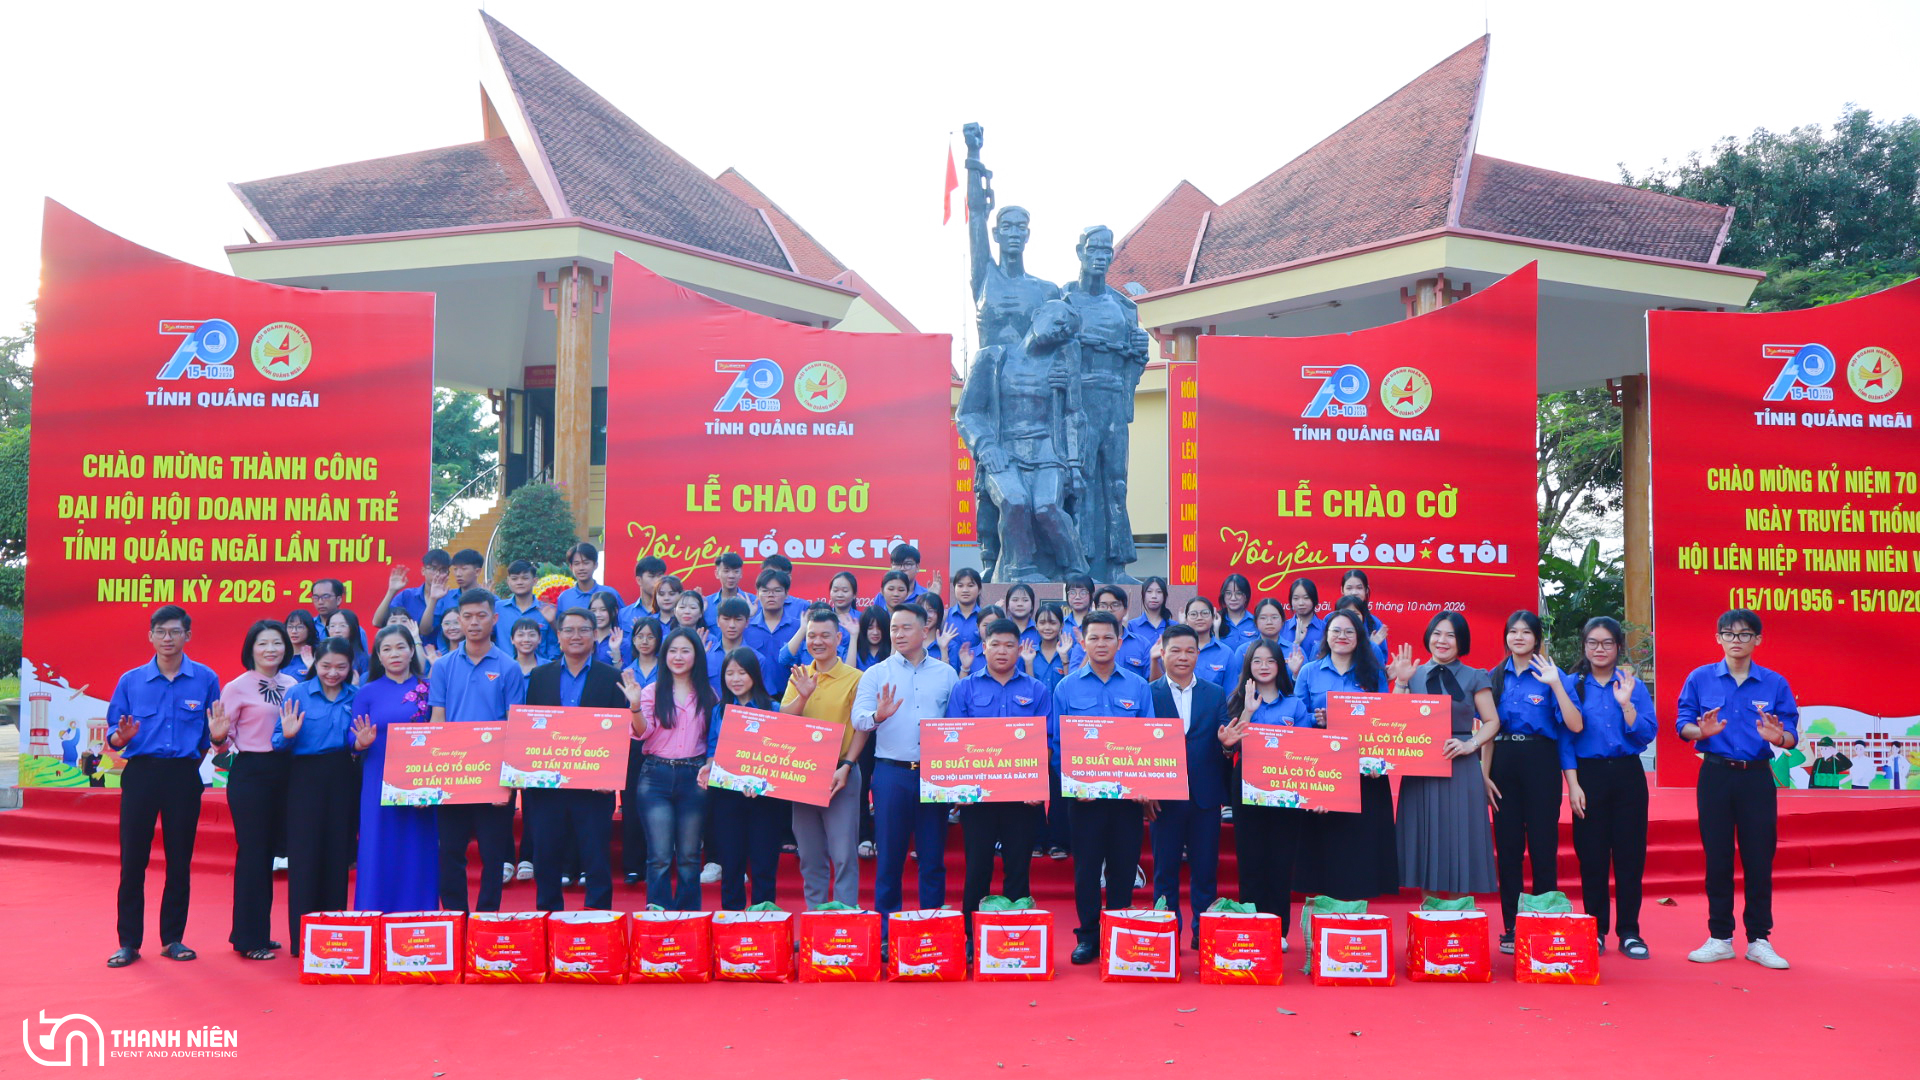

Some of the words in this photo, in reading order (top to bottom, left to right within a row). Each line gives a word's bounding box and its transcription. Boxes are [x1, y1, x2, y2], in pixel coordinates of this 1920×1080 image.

[188, 366, 218, 377] 15-10
[146, 387, 191, 405] TỈNH
[198, 388, 265, 407] QUẢNG
[272, 391, 318, 407] NGÃI
[1792, 388, 1819, 399] 15-10
[741, 400, 766, 410] 15-10
[1328, 406, 1353, 415] 15-10
[705, 419, 743, 434] TỈNH
[749, 419, 807, 436] QUẢNG
[813, 421, 853, 435] NGÃI
[1183, 411, 1196, 428] BAY
[1754, 408, 1796, 425] TỈNH
[1802, 409, 1863, 427] QUẢNG
[1869, 412, 1912, 428] NGÃI
[1293, 424, 1331, 440] TỈNH
[1337, 425, 1394, 441] QUẢNG
[1400, 427, 1439, 441] NGÃI
[1182, 438, 1196, 459] LÊN
[82, 454, 145, 478] CHÀO
[153, 452, 223, 479] MỪNG
[230, 452, 306, 479] THÀNH
[314, 452, 377, 480] CÔNG
[1707, 464, 1754, 491] CHÀO
[1760, 465, 1812, 492] MỪNG
[1818, 463, 1839, 492] KỶ
[1845, 466, 1890, 498] NIỆM
[1895, 471, 1917, 494] 70
[686, 474, 720, 511] LỄ
[732, 479, 816, 512] CHÀO
[827, 479, 869, 512] CỜ
[1278, 480, 1312, 517] LỄ
[1323, 484, 1405, 517] CHÀO
[1416, 484, 1458, 518] CỜ
[58, 495, 97, 524] ĐẠI
[105, 491, 143, 524] HỘI
[152, 492, 190, 525] HỘI
[198, 497, 277, 520] DOANH
[285, 494, 349, 521] NHÂN
[357, 491, 398, 522] TRẺ
[1746, 504, 1792, 531] NGÀY
[1798, 503, 1864, 532] TRUYỀN
[63, 530, 116, 560] TỈNH
[124, 531, 203, 564] QUẢNG
[211, 534, 267, 562] NGÃI
[275, 531, 319, 562] LẦN
[327, 535, 374, 563] THỨ
[377, 538, 392, 566] I,
[741, 528, 778, 558] TỔ
[1333, 534, 1369, 562] TỔ
[1460, 540, 1507, 563] TÔI
[1678, 542, 1708, 574] HỘI
[1713, 543, 1752, 570] LIÊN
[1758, 544, 1797, 576] HIỆP
[1803, 548, 1860, 572] THANH
[1866, 545, 1908, 572] NIÊN
[98, 579, 175, 607] NHIỆM
[182, 579, 211, 604] KỲ
[219, 580, 275, 603] 2026
[299, 580, 353, 606] 21
[1730, 587, 1832, 611] (15/10/1956
[1375, 602, 1403, 613] tháng
[1407, 602, 1417, 610] 10
[1419, 602, 1441, 611] năm
[1444, 602, 1465, 611] 2026
[1365, 733, 1374, 742] LÁ
[1377, 733, 1390, 743] CỜ
[1392, 732, 1403, 743] TỔ
[1406, 733, 1431, 744] QUỐC
[1071, 756, 1083, 764] 50
[1086, 753, 1110, 765] SUẤT
[1112, 755, 1134, 765] QUÀ
[1137, 758, 1151, 766] AN
[1154, 758, 1176, 766] SINH
[1368, 744, 1384, 755] TẤN
[1386, 748, 1395, 756] XI
[1398, 747, 1424, 757] MĂNG
[736, 750, 750, 759] 200
[752, 751, 762, 761] LÁ
[764, 754, 778, 763] CỜ
[779, 754, 790, 766] TỔ
[792, 760, 817, 771] QUỐC
[930, 760, 942, 768] 50
[946, 756, 969, 768] SUẤT
[972, 757, 994, 768] QUÀ
[1015, 758, 1037, 767] SINH
[740, 764, 751, 773] 02
[753, 764, 768, 776] TẤN
[770, 770, 779, 778] XI
[781, 770, 806, 782] MĂNG
[946, 773, 958, 782] HỘI
[1262, 766, 1276, 774] 200
[1278, 766, 1288, 775] LÁ
[1290, 767, 1303, 776] CỜ
[1305, 765, 1315, 777] TỔ
[1318, 769, 1342, 779] QUỐC
[1282, 778, 1297, 789] TẤN
[1300, 782, 1308, 790] XI
[1310, 781, 1335, 792] MĂNG
